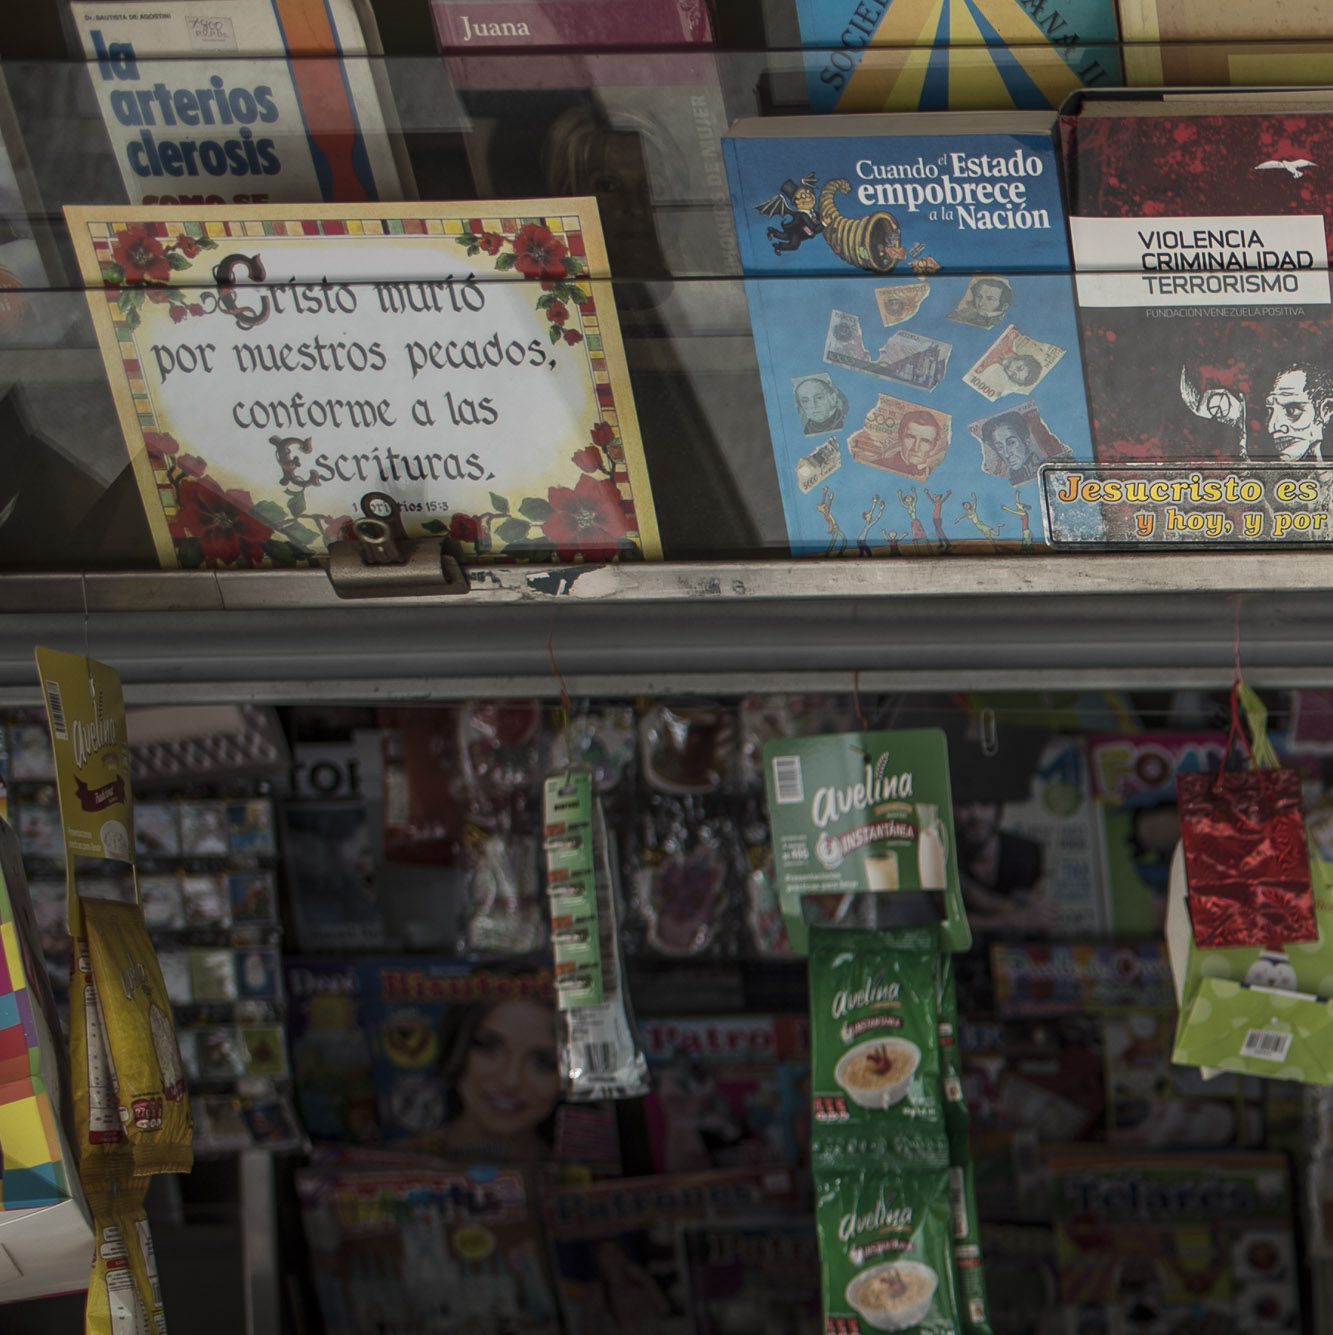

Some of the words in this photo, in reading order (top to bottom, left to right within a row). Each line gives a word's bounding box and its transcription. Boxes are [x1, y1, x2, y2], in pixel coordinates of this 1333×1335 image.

[461, 16, 530, 40] Juana
[90, 30, 140, 80] la
[111, 76, 279, 126] arterios
[127, 128, 281, 177] clerosis
[856, 158, 938, 180] Cuando
[938, 154, 947, 166] el
[950, 150, 1043, 178] Estado
[858, 175, 1026, 211] empobrece
[929, 210, 938, 220] a
[941, 207, 953, 220] la
[956, 204, 1050, 230] Nación
[1138, 230, 1264, 249] VIOLENCIA
[1142, 250, 1313, 271] CRIMINALIDAD
[200, 253, 358, 330] Cristo
[373, 273, 485, 314] murió
[1142, 274, 1298, 295] TERRORISMO
[150, 340, 216, 384] por
[233, 335, 387, 373] nuestros
[405, 332, 557, 380] pecados,
[233, 392, 396, 429] conforme
[412, 400, 435, 426] a
[444, 392, 498, 426] las
[269, 435, 496, 489] Escrituras.
[1058, 475, 1261, 504] Jesucristo
[1274, 478, 1319, 503] es
[1136, 511, 1153, 536] y
[1168, 509, 1232, 536] hoy,
[1244, 511, 1263, 536] y
[1273, 510, 1327, 536] por
